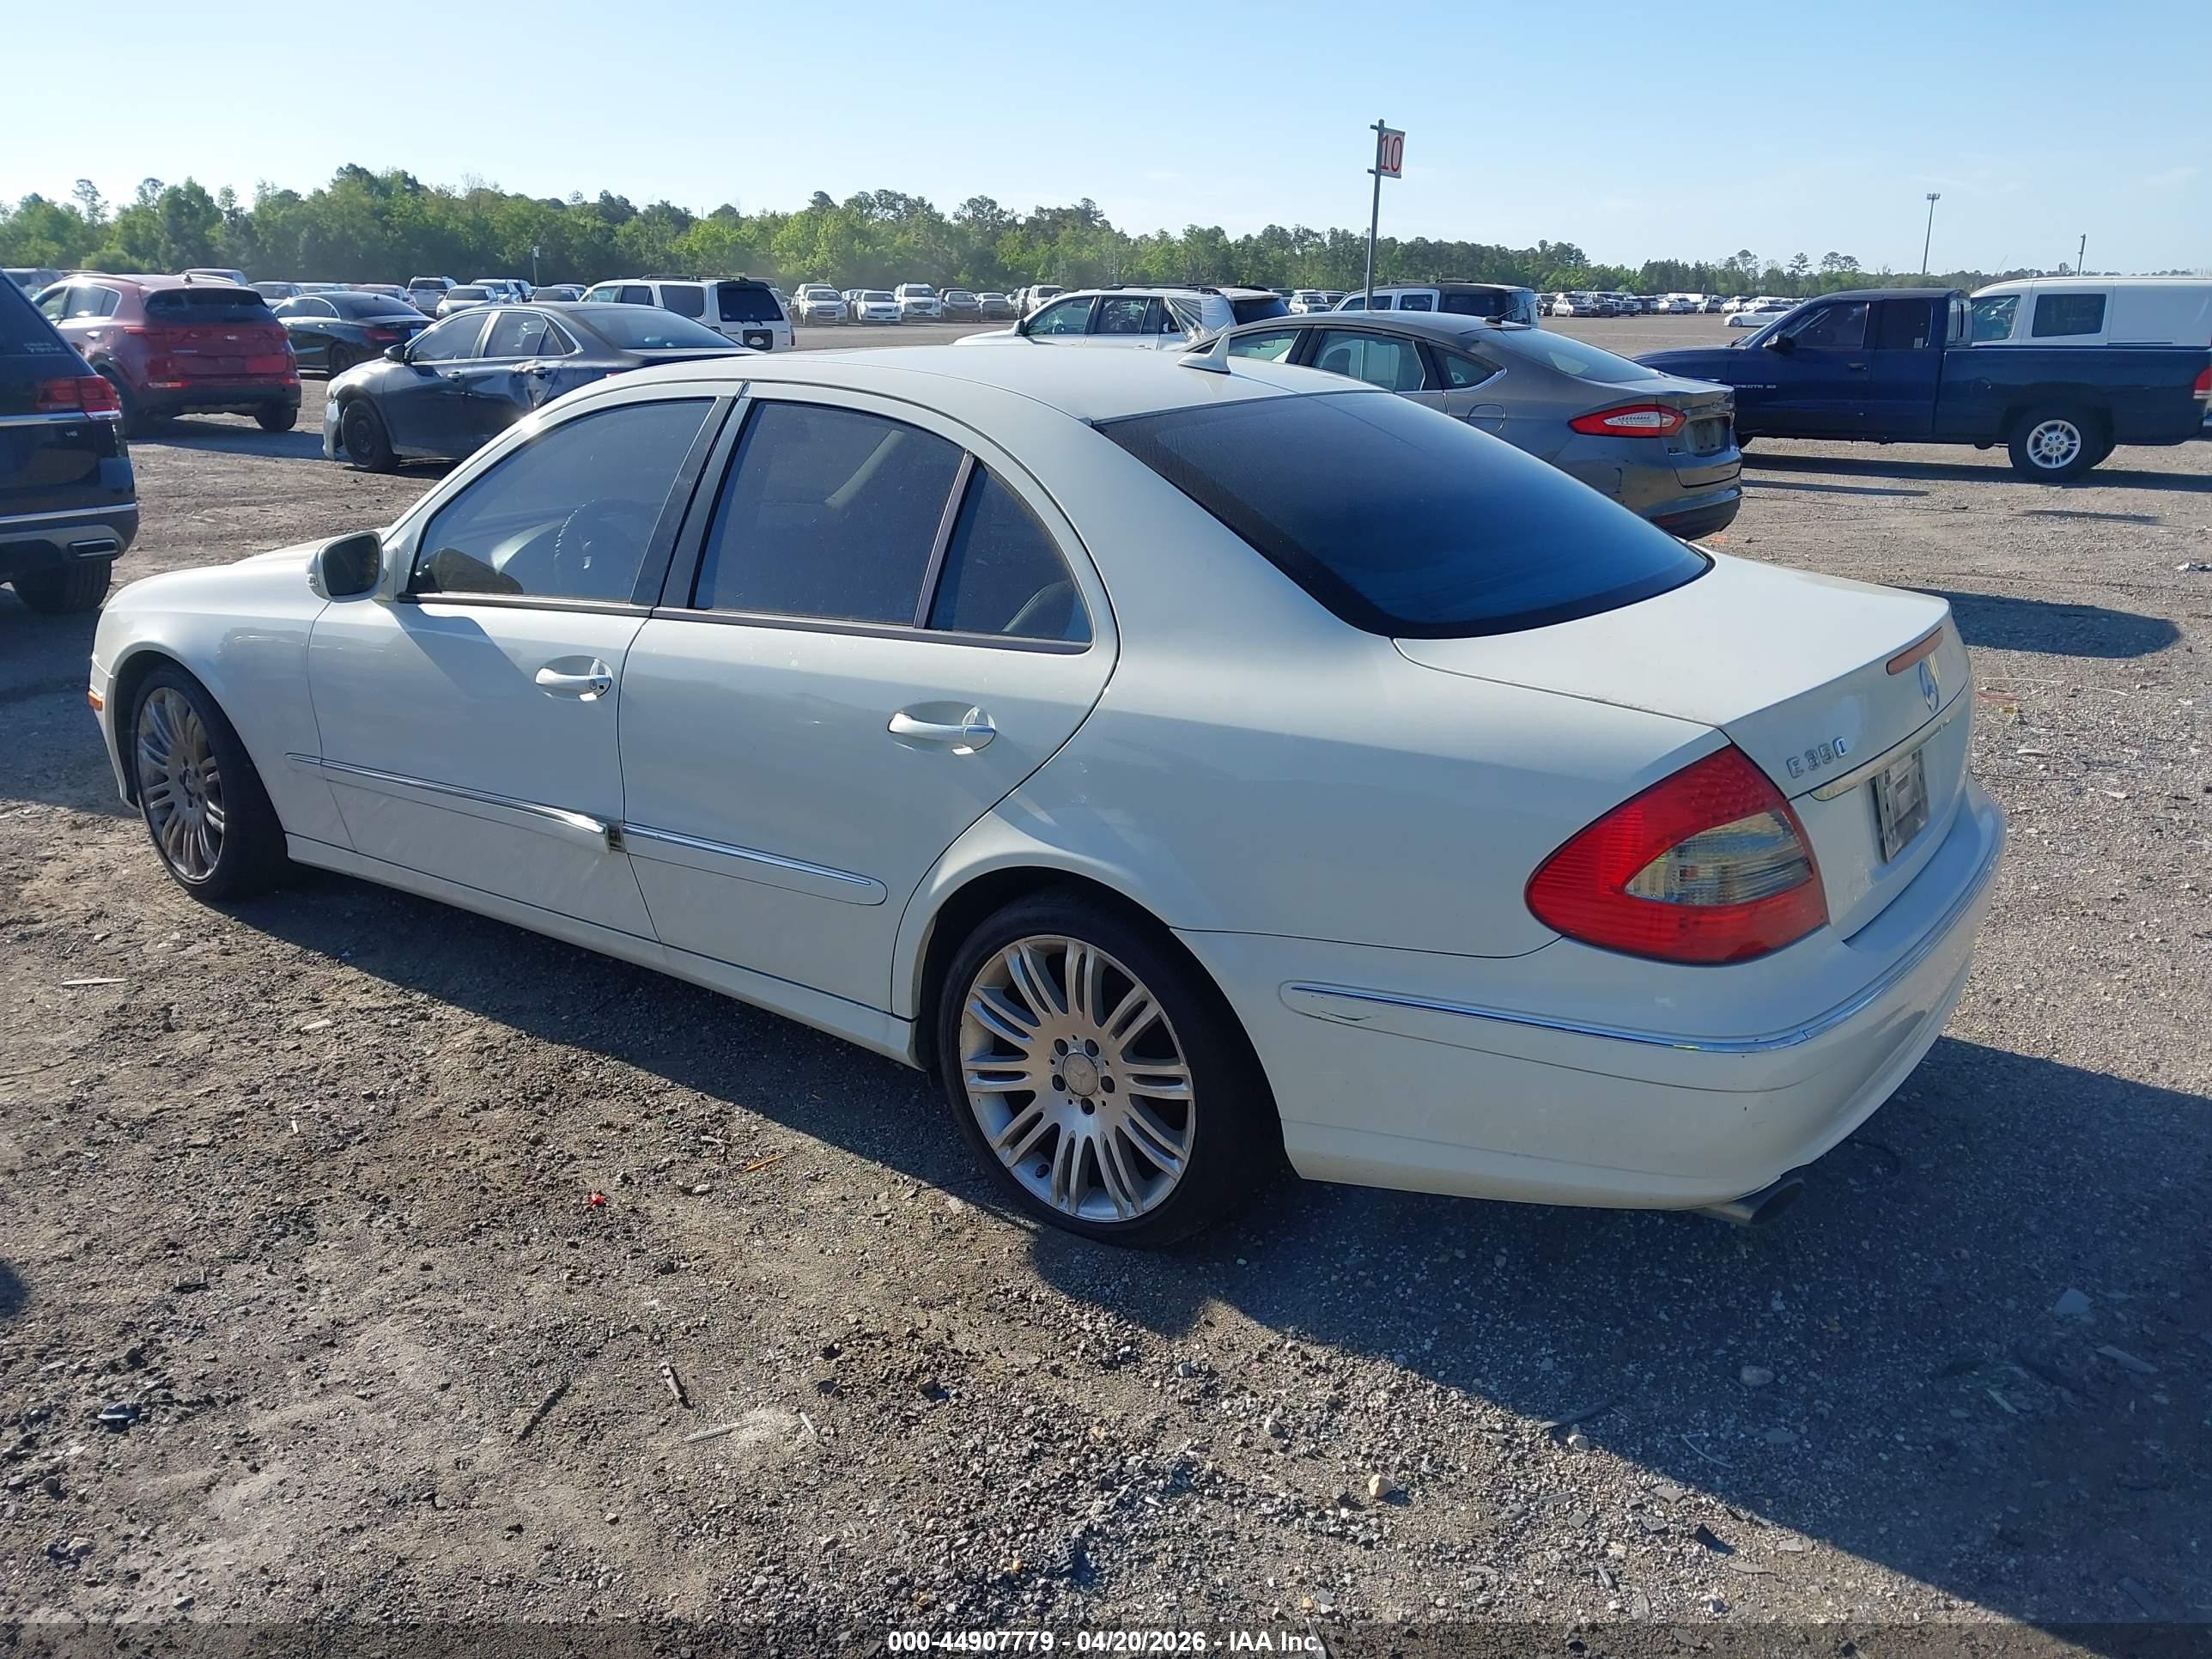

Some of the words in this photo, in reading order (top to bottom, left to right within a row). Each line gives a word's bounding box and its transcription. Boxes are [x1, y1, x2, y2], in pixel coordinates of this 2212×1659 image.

[1380, 134, 1402, 173] 10
[1786, 756, 1805, 779] E
[1804, 736, 1848, 771] 350
